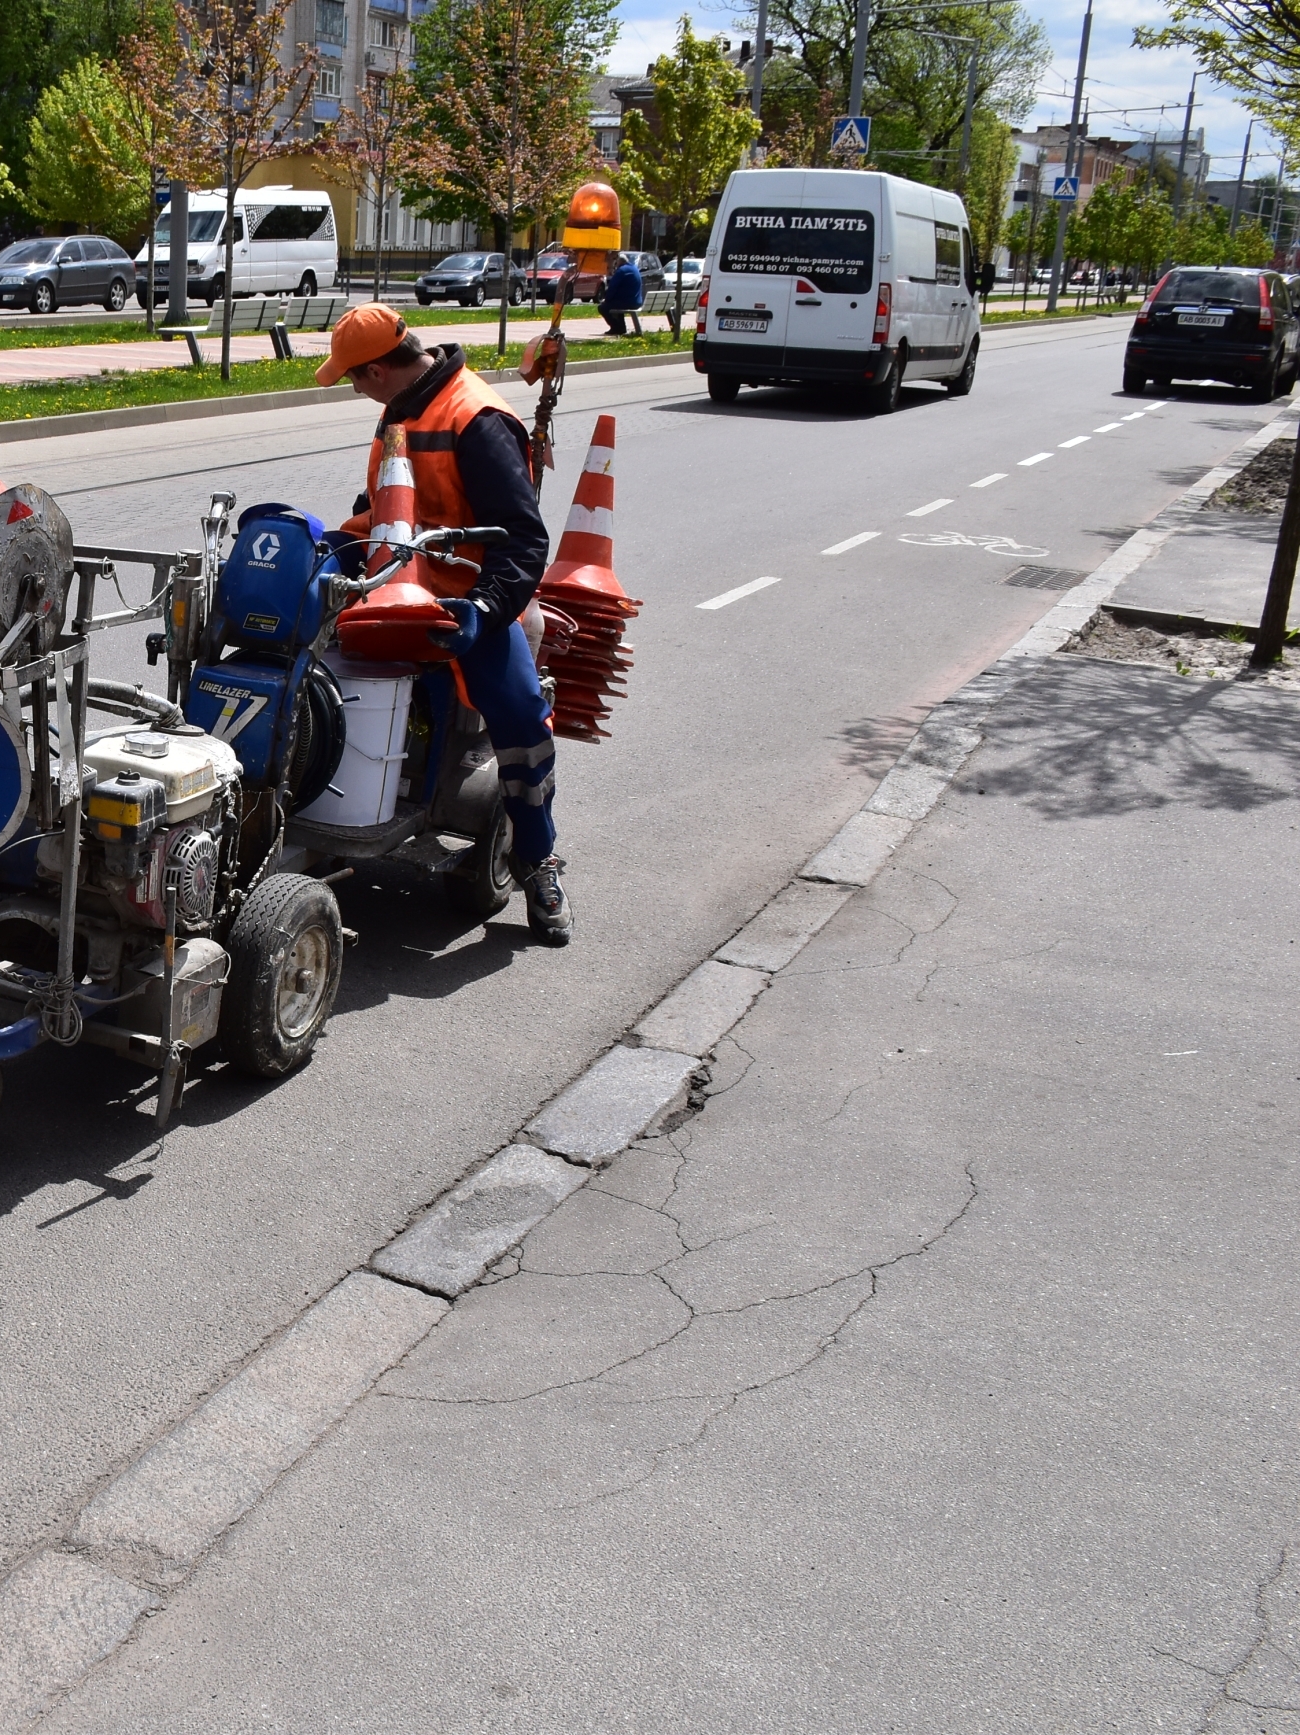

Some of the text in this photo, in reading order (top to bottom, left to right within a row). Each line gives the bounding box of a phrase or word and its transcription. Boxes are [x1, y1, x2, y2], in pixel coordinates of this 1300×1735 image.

[735, 216, 785, 228] ВІЧНА
[728, 254, 864, 266] 0432 694949 vichna-pamyat.com
[731, 263, 746, 271] 067
[766, 264, 777, 272] 80
[796, 265, 812, 273] 093
[815, 266, 831, 274] 460
[833, 266, 844, 274] 09
[846, 267, 858, 275] 22
[723, 320, 765, 330] AB 5969 IA
[247, 560, 276, 569] GRACO
[199, 681, 251, 699] LINELAZER
